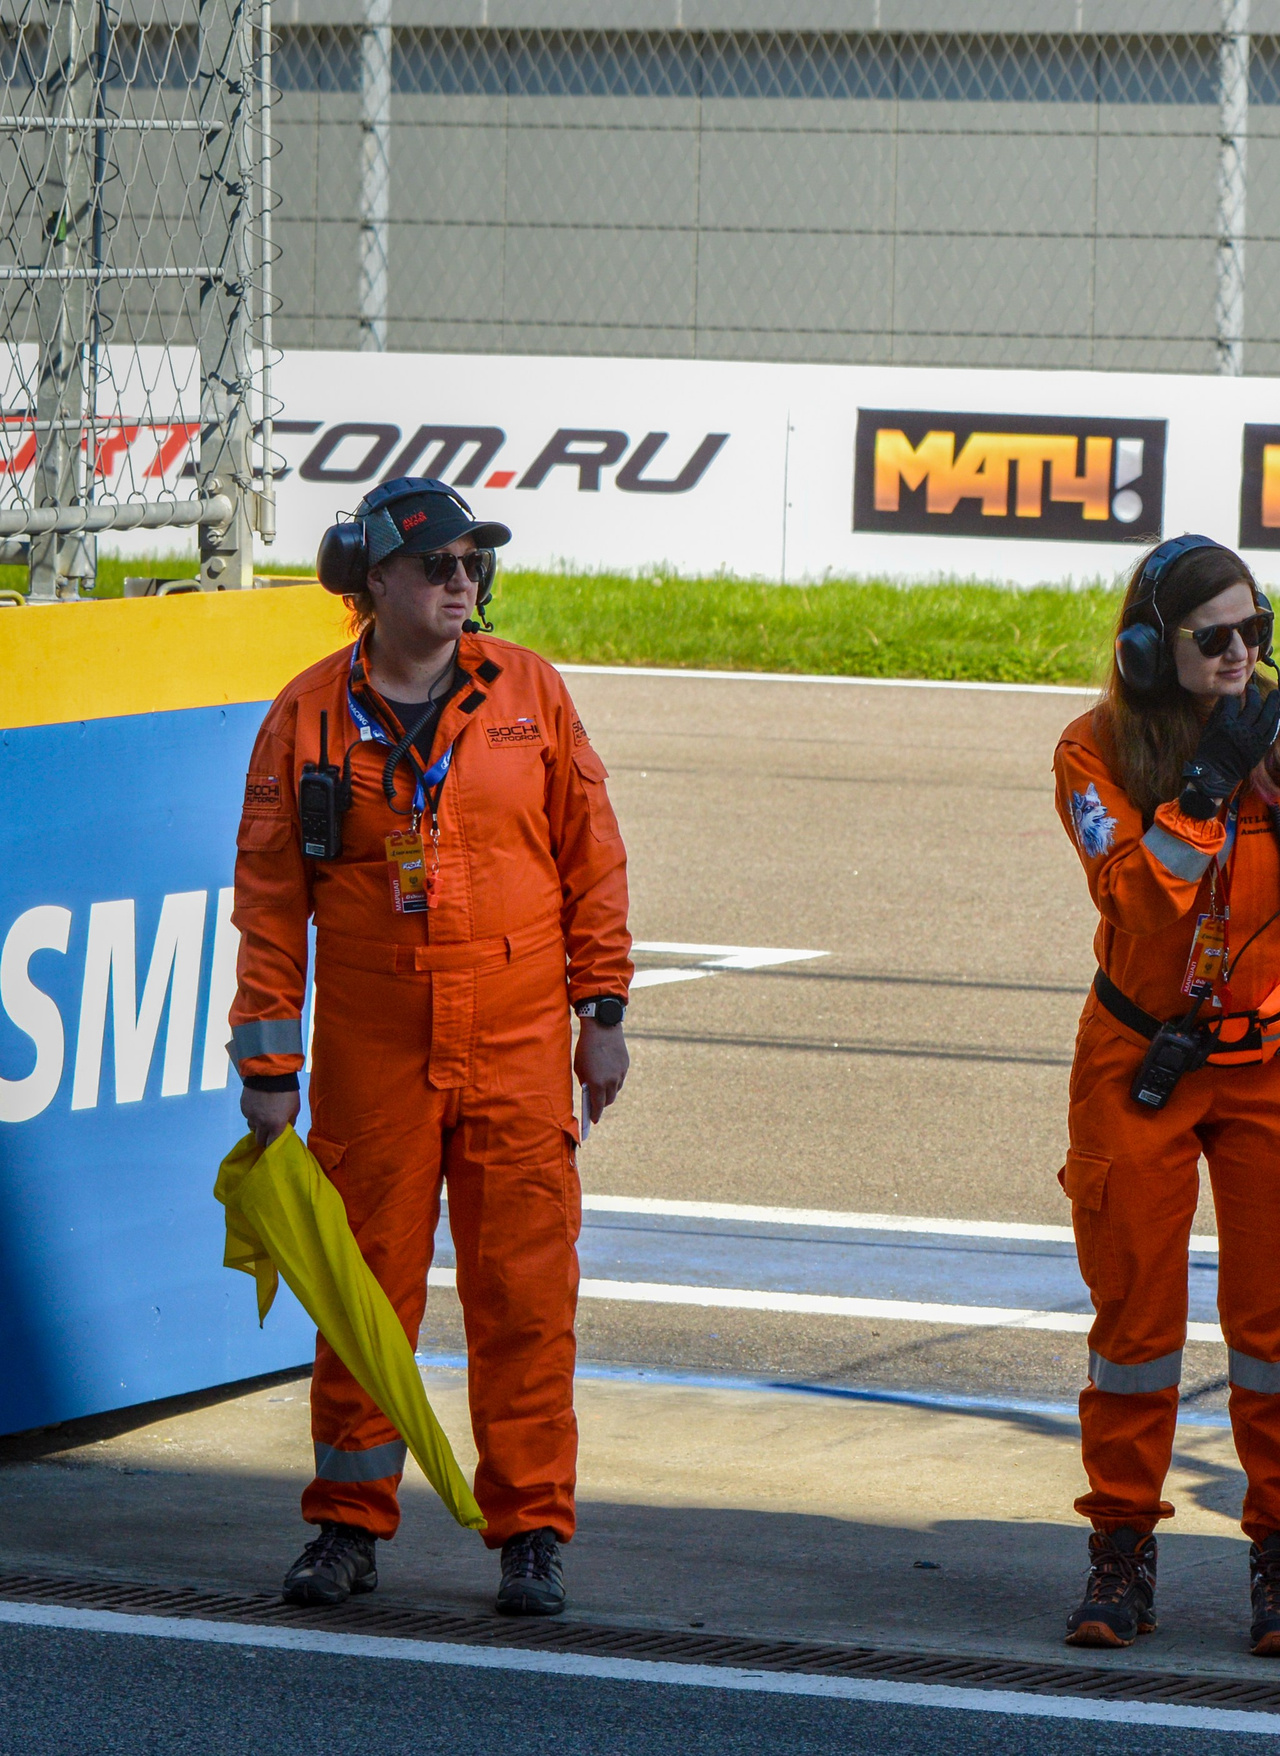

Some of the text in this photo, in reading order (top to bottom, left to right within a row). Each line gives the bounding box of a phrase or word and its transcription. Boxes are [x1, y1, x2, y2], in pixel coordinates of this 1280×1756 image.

[486, 725, 540, 737] SOCHI
[490, 734, 541, 742] AUTODROM
[246, 784, 280, 796] SOCHI
